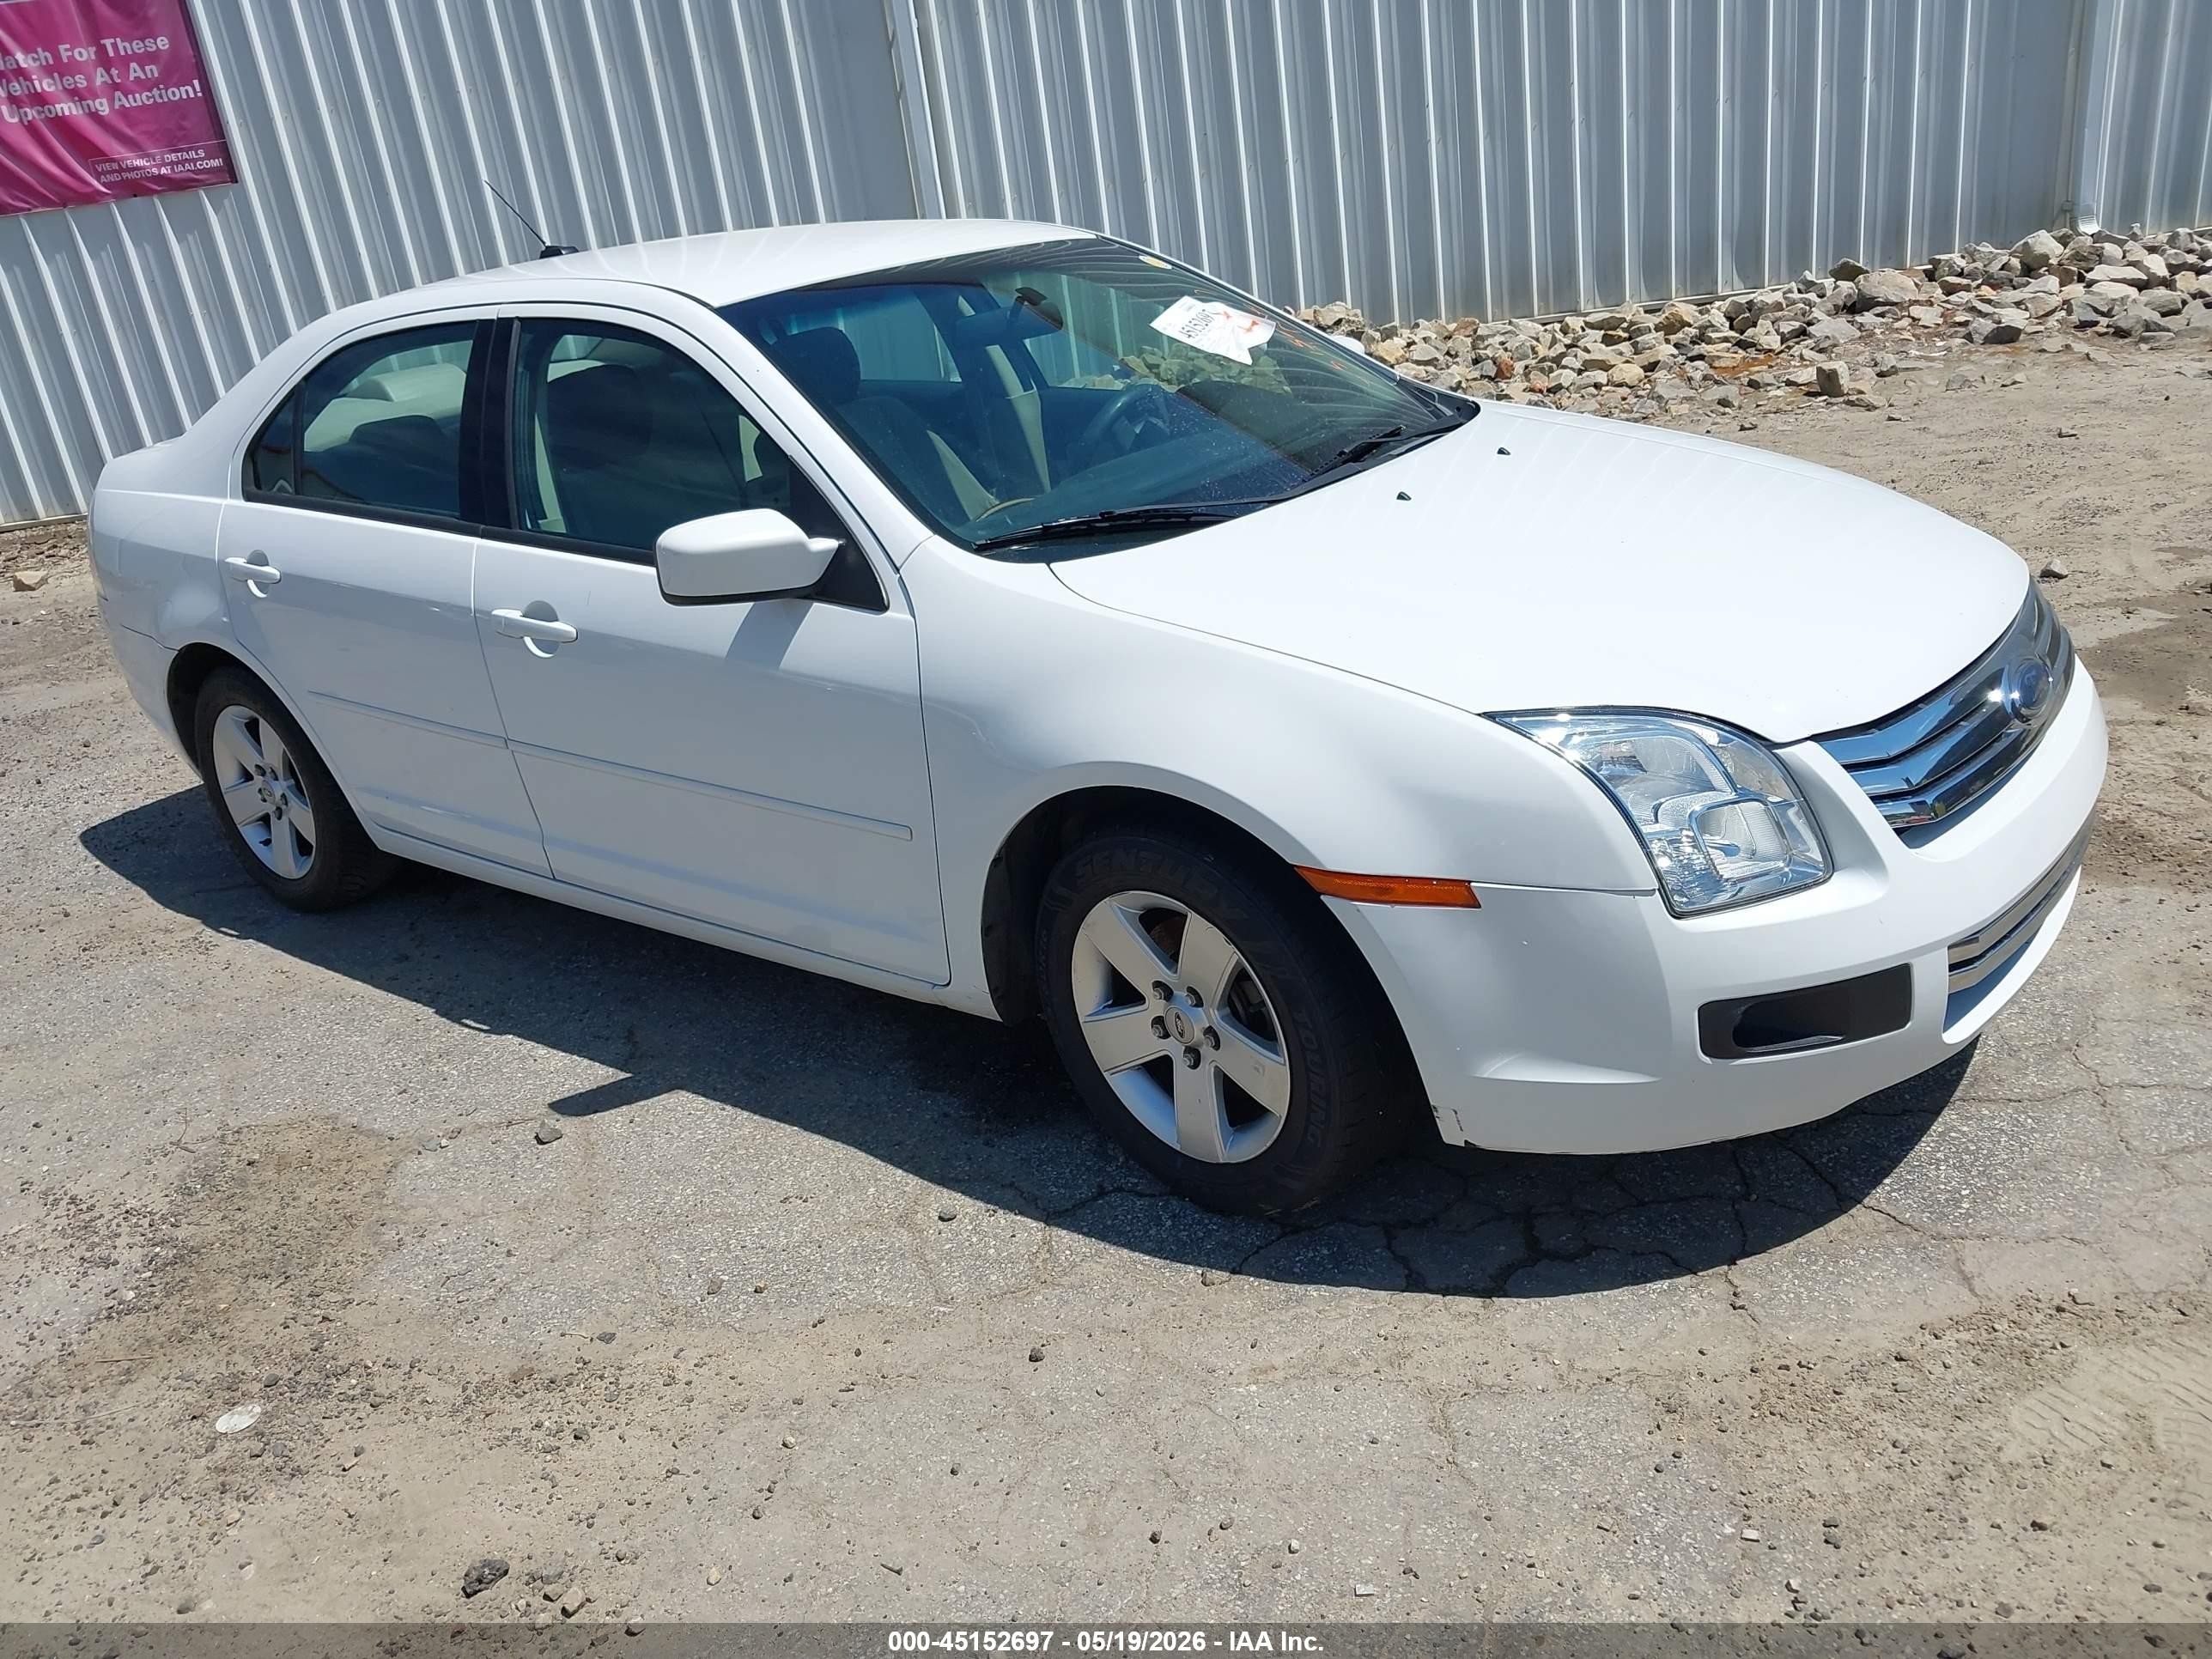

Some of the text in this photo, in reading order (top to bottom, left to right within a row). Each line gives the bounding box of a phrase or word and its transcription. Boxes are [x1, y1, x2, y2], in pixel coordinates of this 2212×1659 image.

[0, 36, 169, 70] atch For These
[96, 67, 122, 86] At
[129, 62, 159, 81] An
[1, 79, 203, 125] Upcoming Auction!
[94, 149, 206, 173] VIEW VEHICLE DETAILS
[100, 157, 224, 184] AND PHOTOS AT IAAI.COM!
